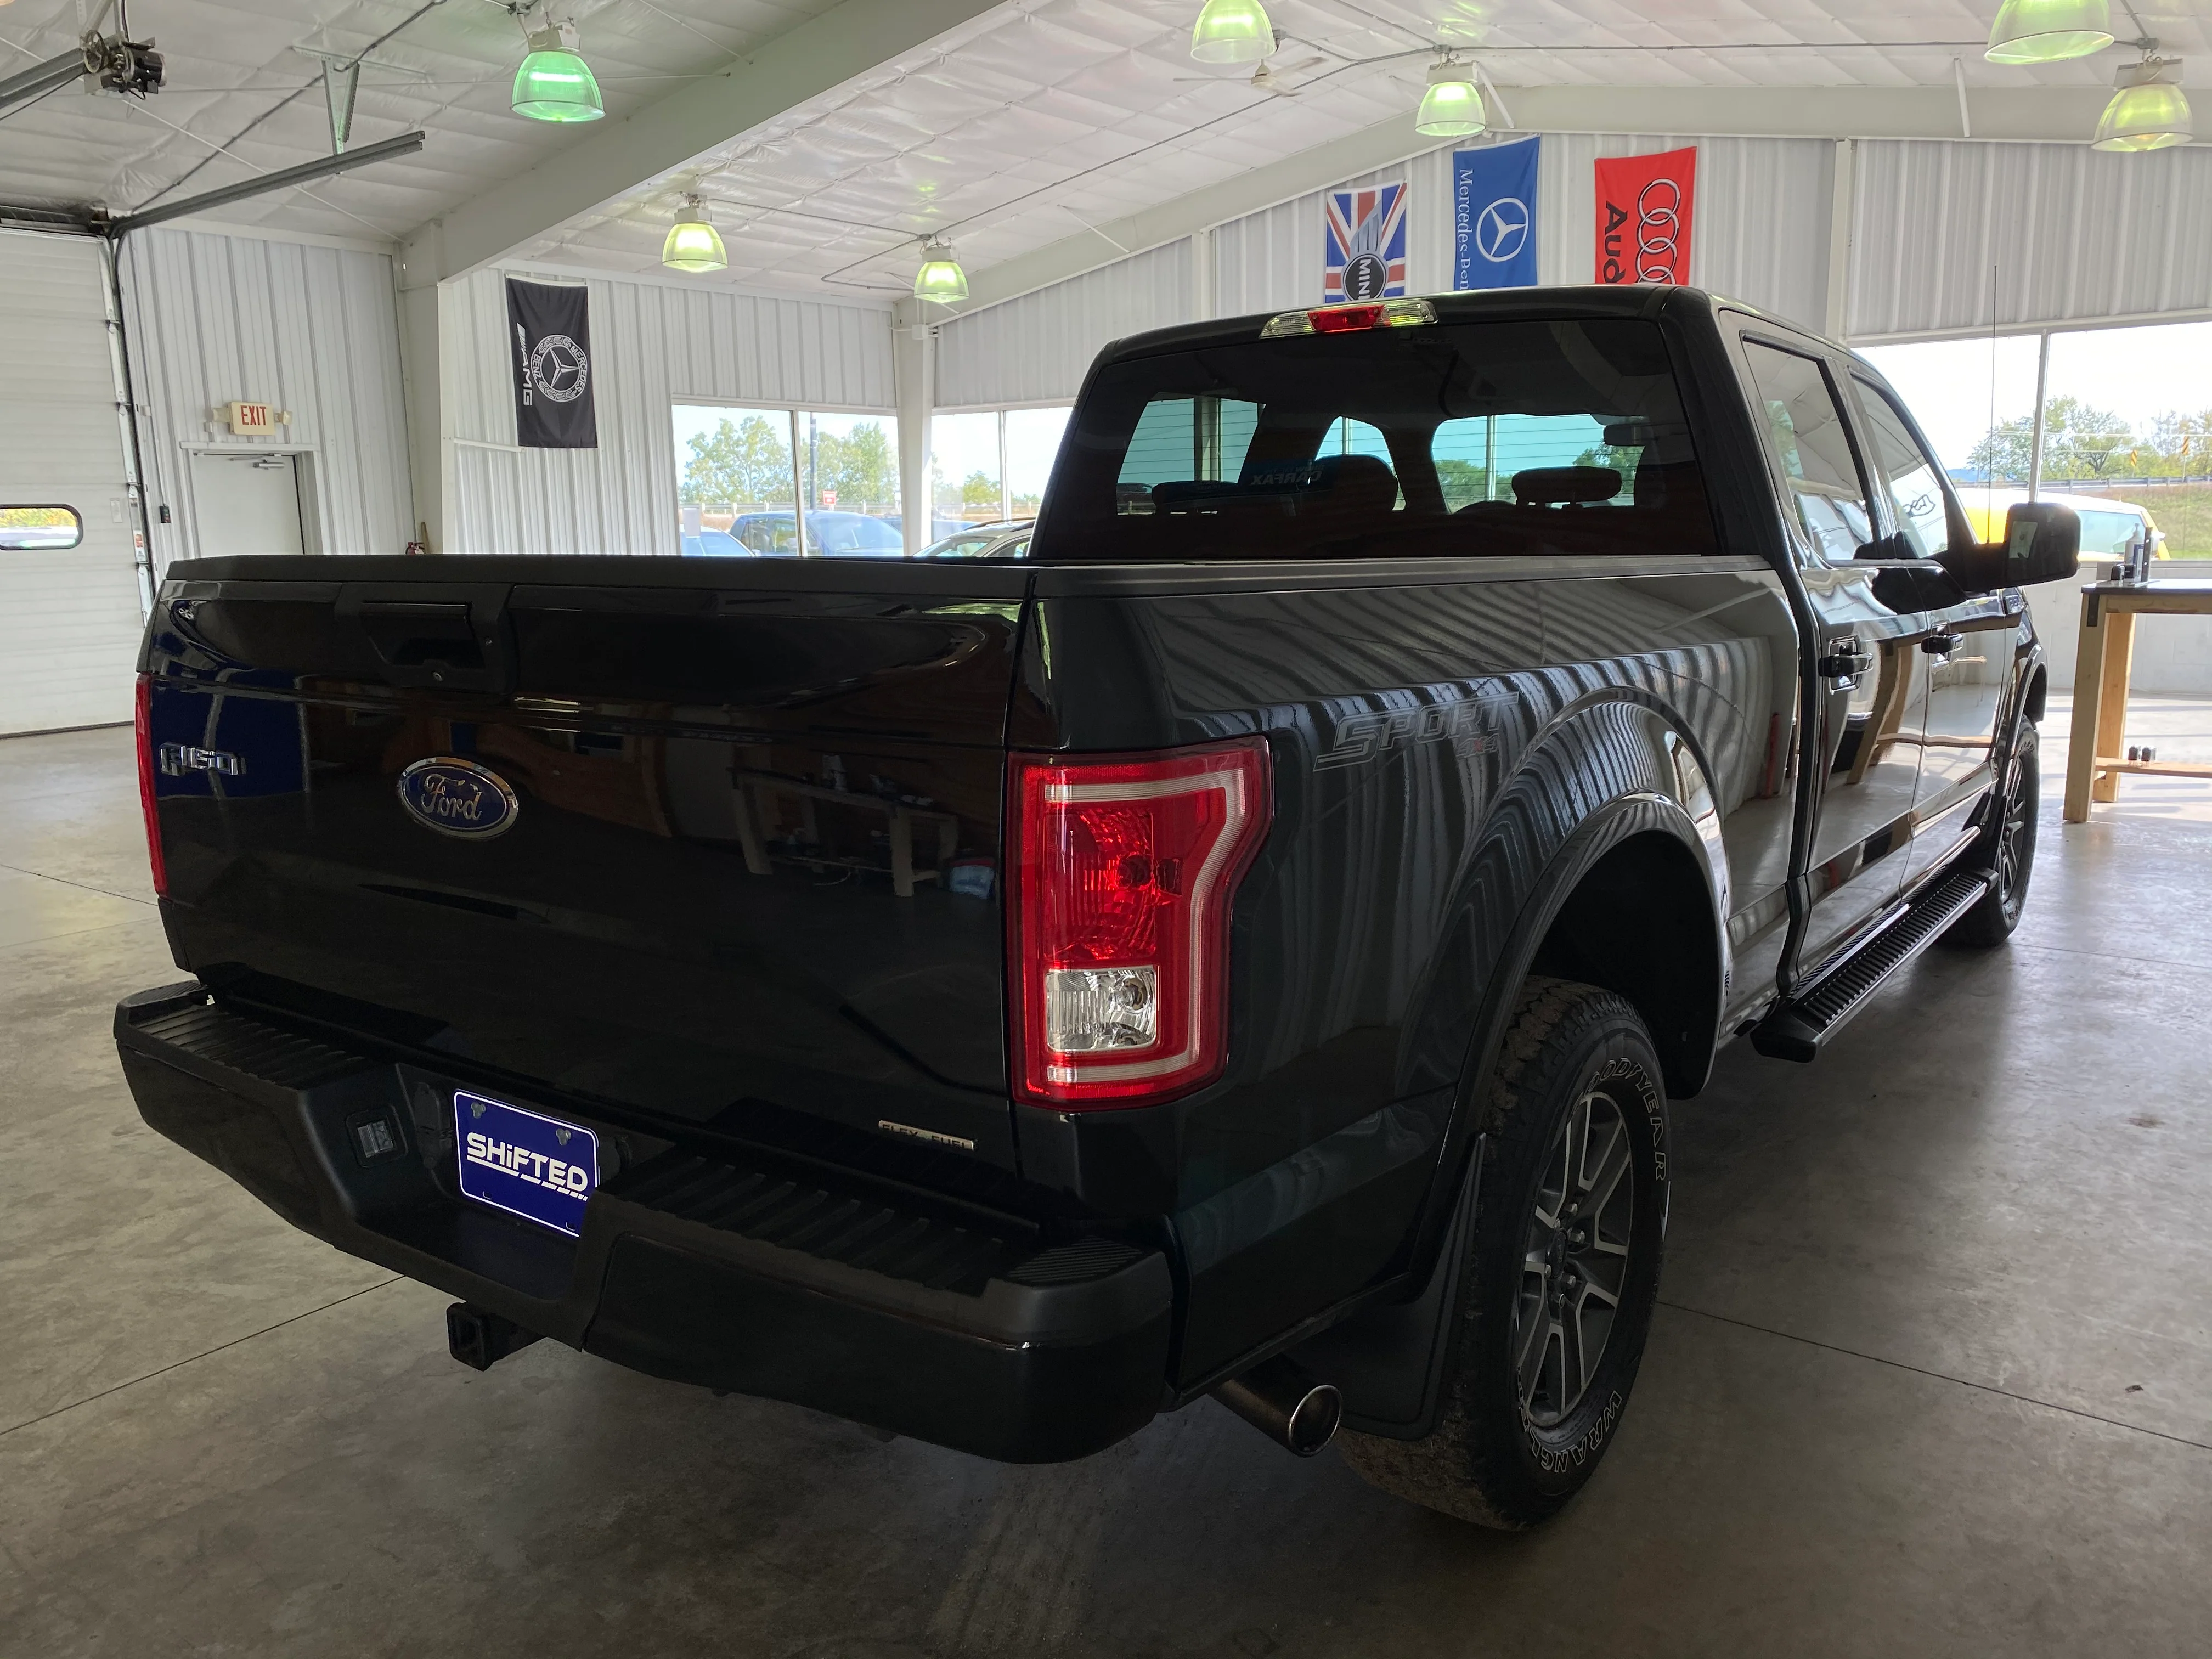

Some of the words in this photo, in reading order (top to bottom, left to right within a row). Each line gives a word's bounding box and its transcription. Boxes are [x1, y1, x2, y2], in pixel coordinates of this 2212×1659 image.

[1457, 168, 1474, 290] Mercedes-Ben
[1603, 200, 1628, 284] Aud
[1358, 258, 1372, 300] MINI
[532, 354, 541, 379] BENZ
[571, 345, 586, 392] MERCEDES
[240, 405, 266, 426] EXIT
[1313, 691, 1519, 772] SPORT
[420, 773, 482, 820] Ford
